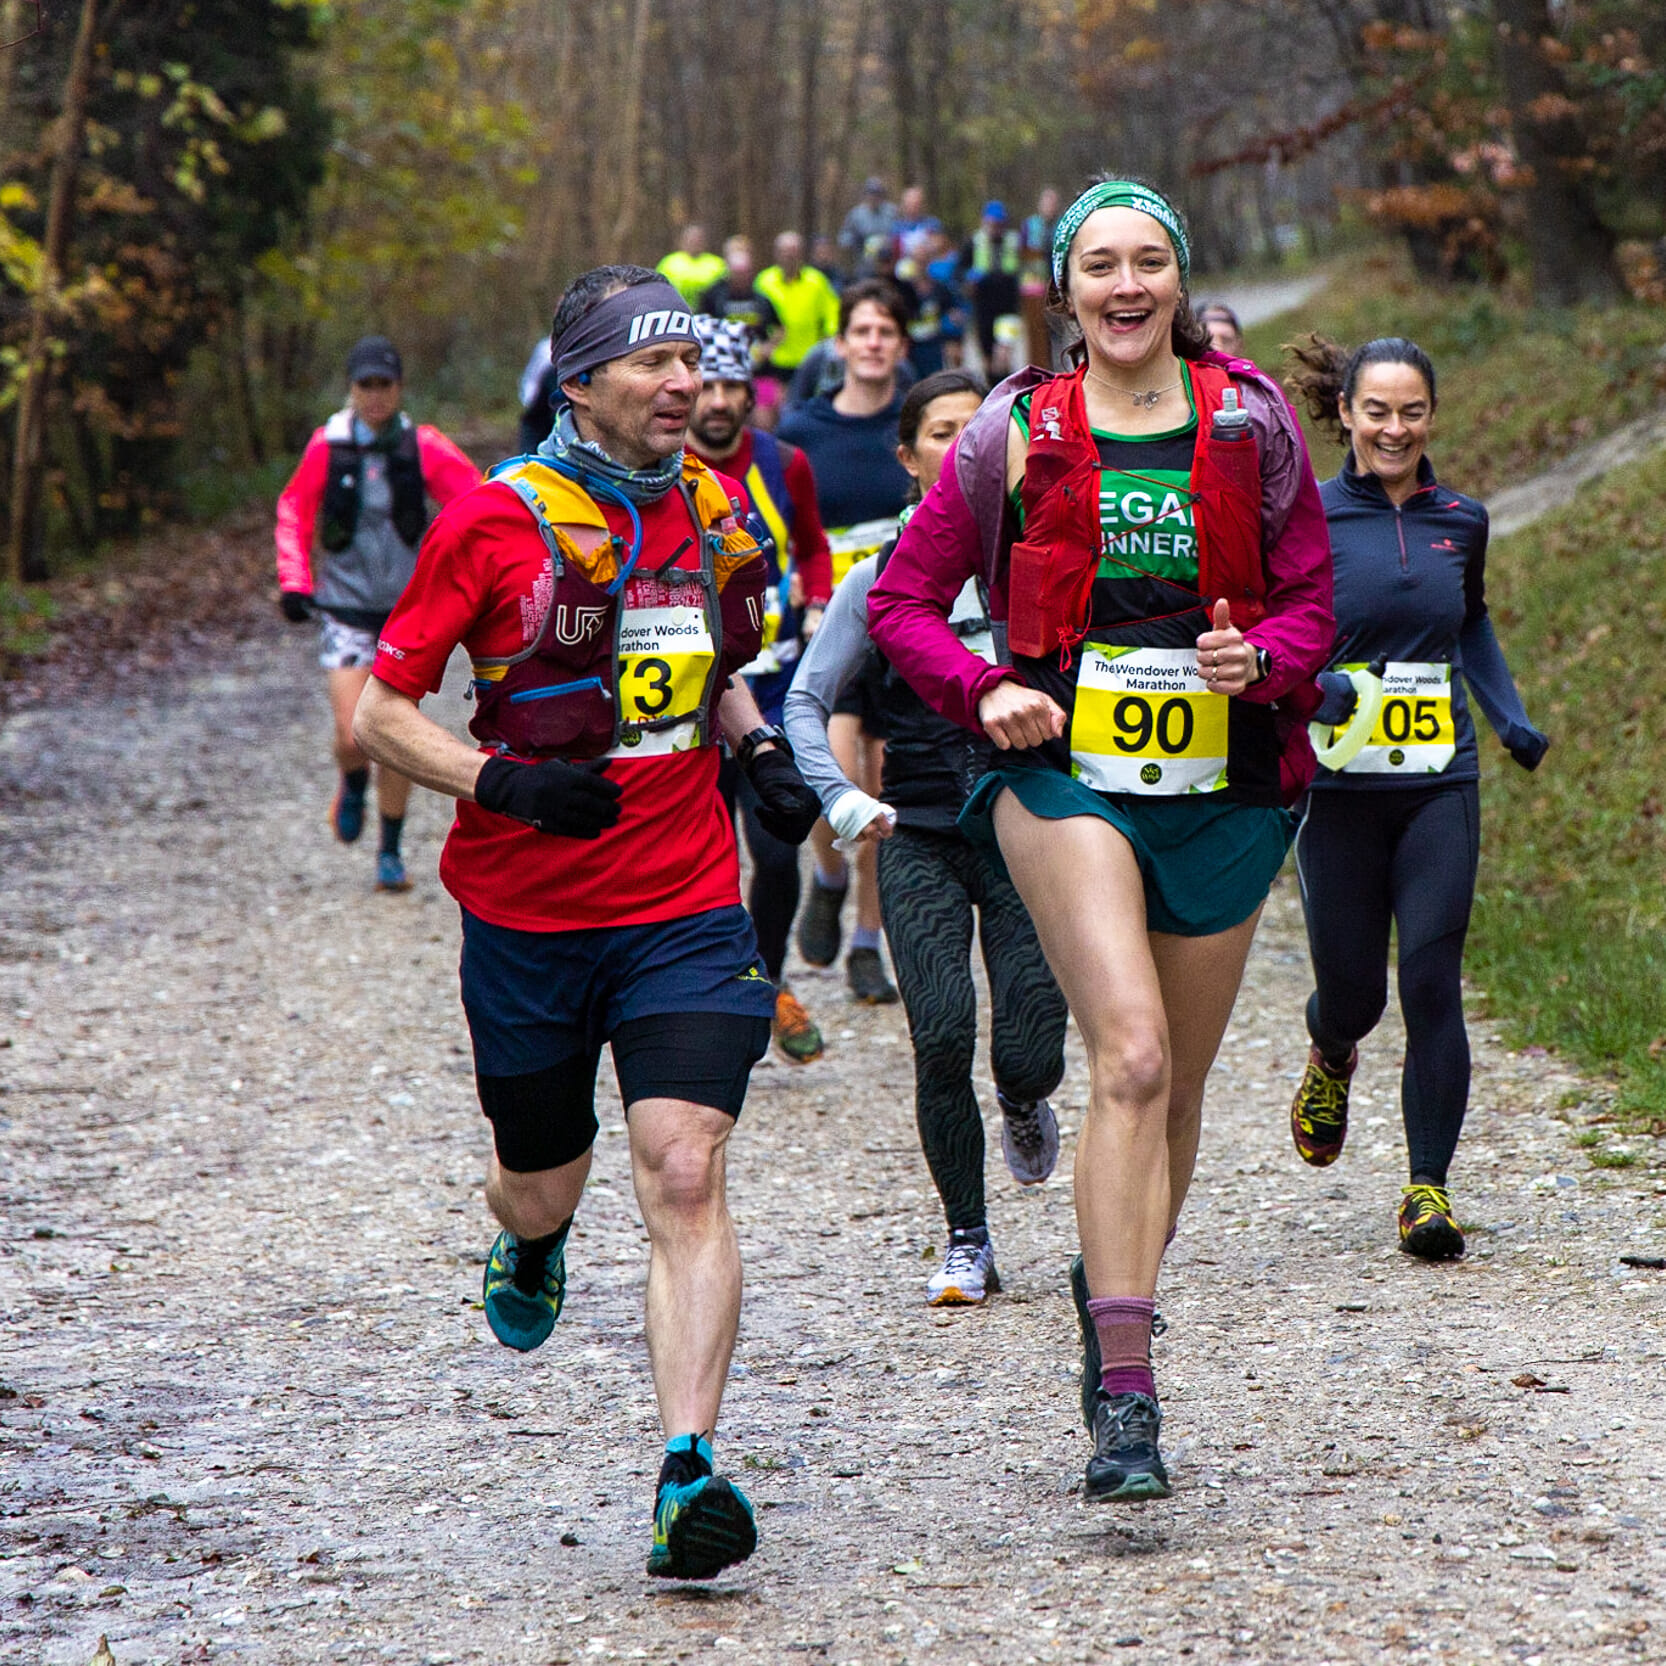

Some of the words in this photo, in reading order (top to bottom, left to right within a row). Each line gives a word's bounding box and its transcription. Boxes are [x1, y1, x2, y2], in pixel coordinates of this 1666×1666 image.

[628, 310, 701, 345] INO
[1098, 491, 1196, 527] EGA
[1101, 531, 1199, 558] NNER
[620, 626, 651, 638] dover
[654, 624, 700, 636] Woods
[618, 641, 660, 652] rathon
[1094, 660, 1116, 674] The
[1115, 663, 1180, 677] Wendover
[1126, 677, 1186, 691] Marathon
[1382, 675, 1413, 684] dover
[1382, 686, 1417, 694] arathon
[1112, 696, 1194, 754] 90
[1383, 699, 1441, 742] 05
